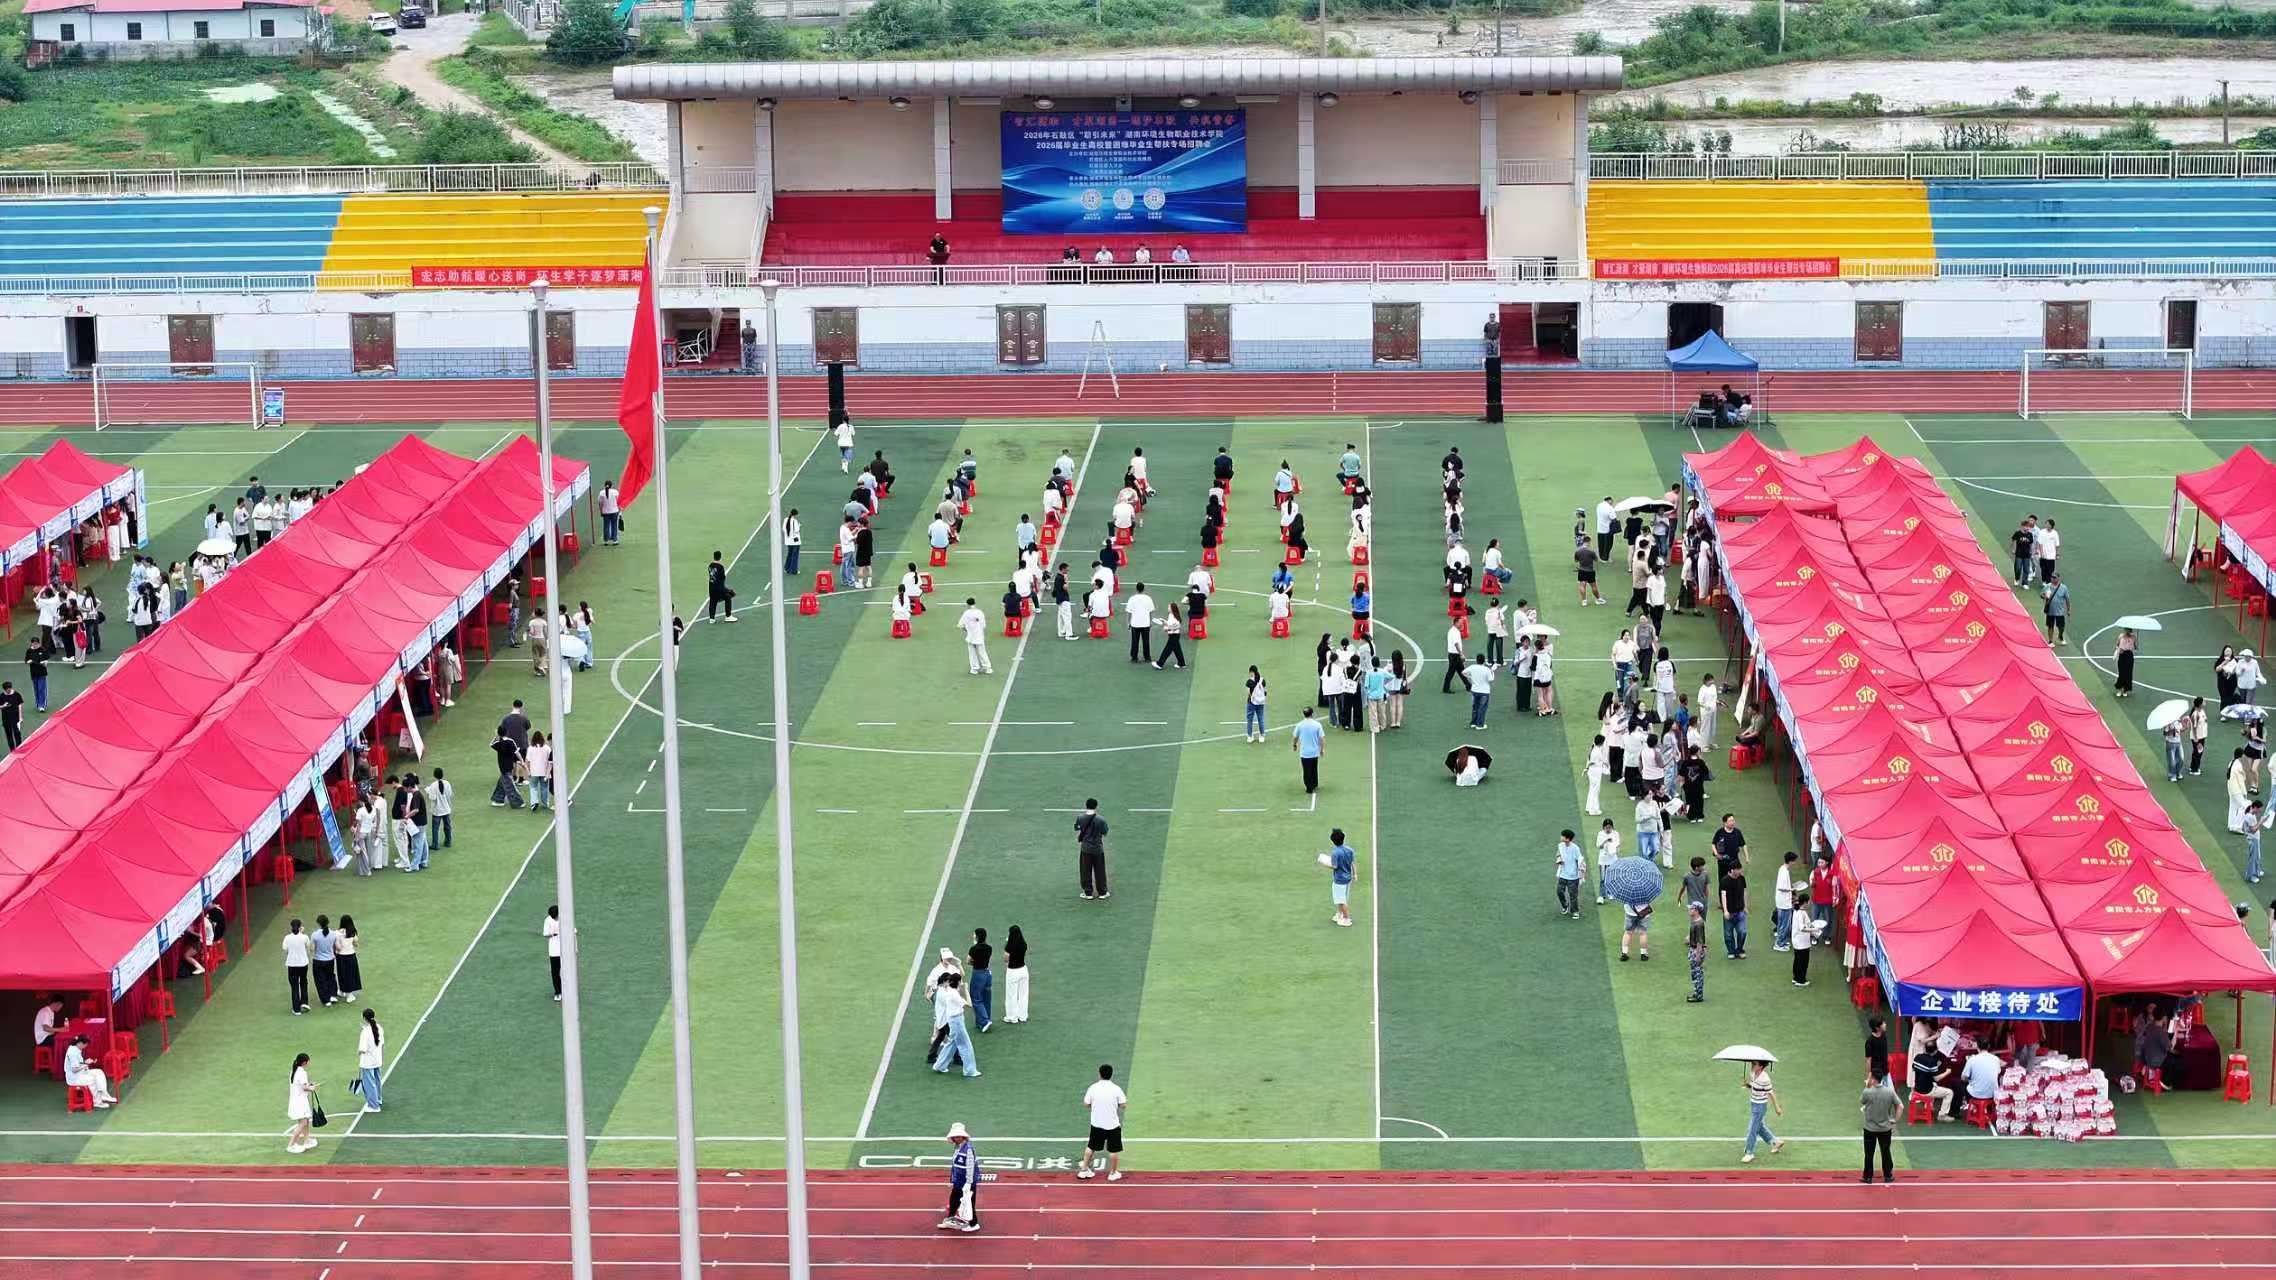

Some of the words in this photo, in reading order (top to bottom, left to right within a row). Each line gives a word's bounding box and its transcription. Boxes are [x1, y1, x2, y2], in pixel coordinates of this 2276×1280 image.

[421, 270, 527, 283] 宏志助航暖心送岗
[1920, 989, 2060, 1014] 企业接待处
